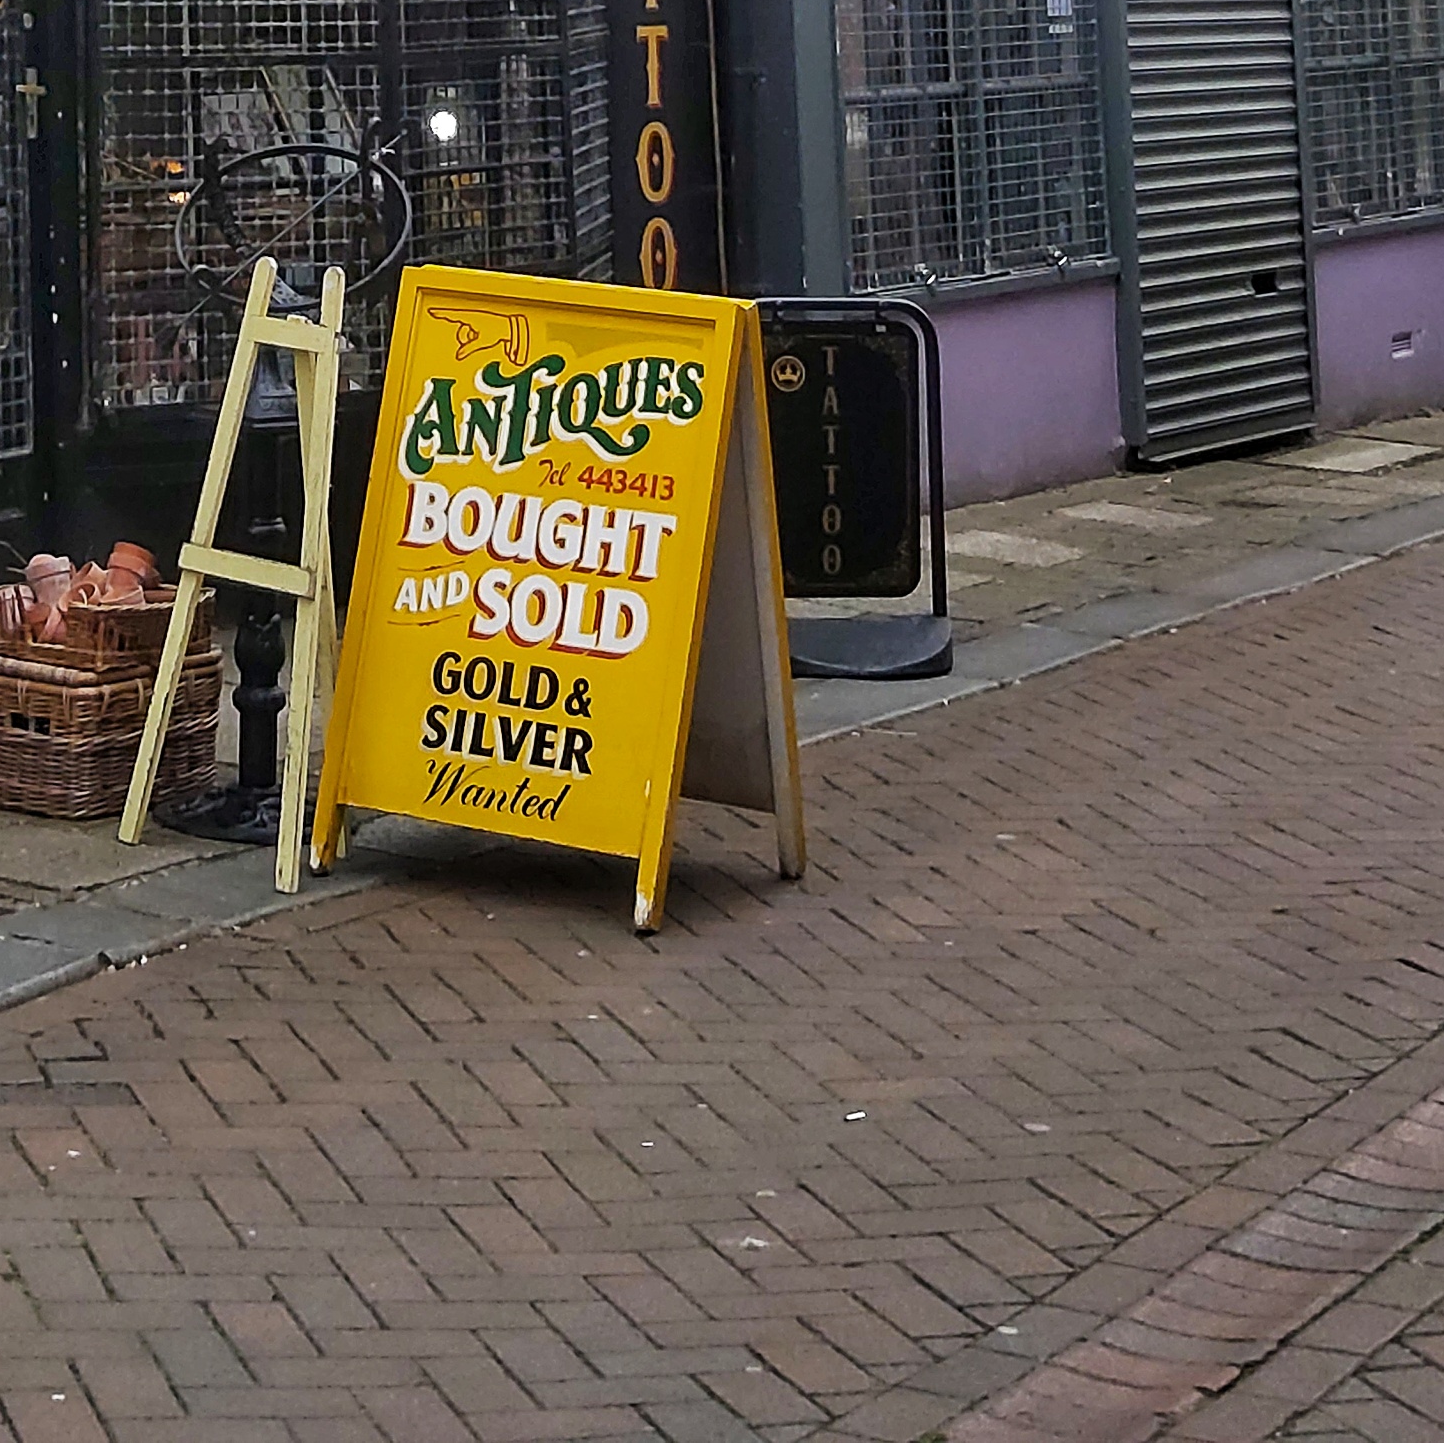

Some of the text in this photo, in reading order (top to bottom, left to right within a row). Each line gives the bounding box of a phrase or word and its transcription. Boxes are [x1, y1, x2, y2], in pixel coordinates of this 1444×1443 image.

[399, 354, 705, 479] ANTIQUES
[538, 458, 676, 501] Tel 443413
[820, 345, 842, 575] TATTOO
[398, 480, 677, 582] BOUGHT
[394, 568, 649, 660] AND SOLD
[431, 651, 593, 719] GOLD &
[421, 703, 594, 778] SILVER
[422, 758, 572, 822] Wanted
